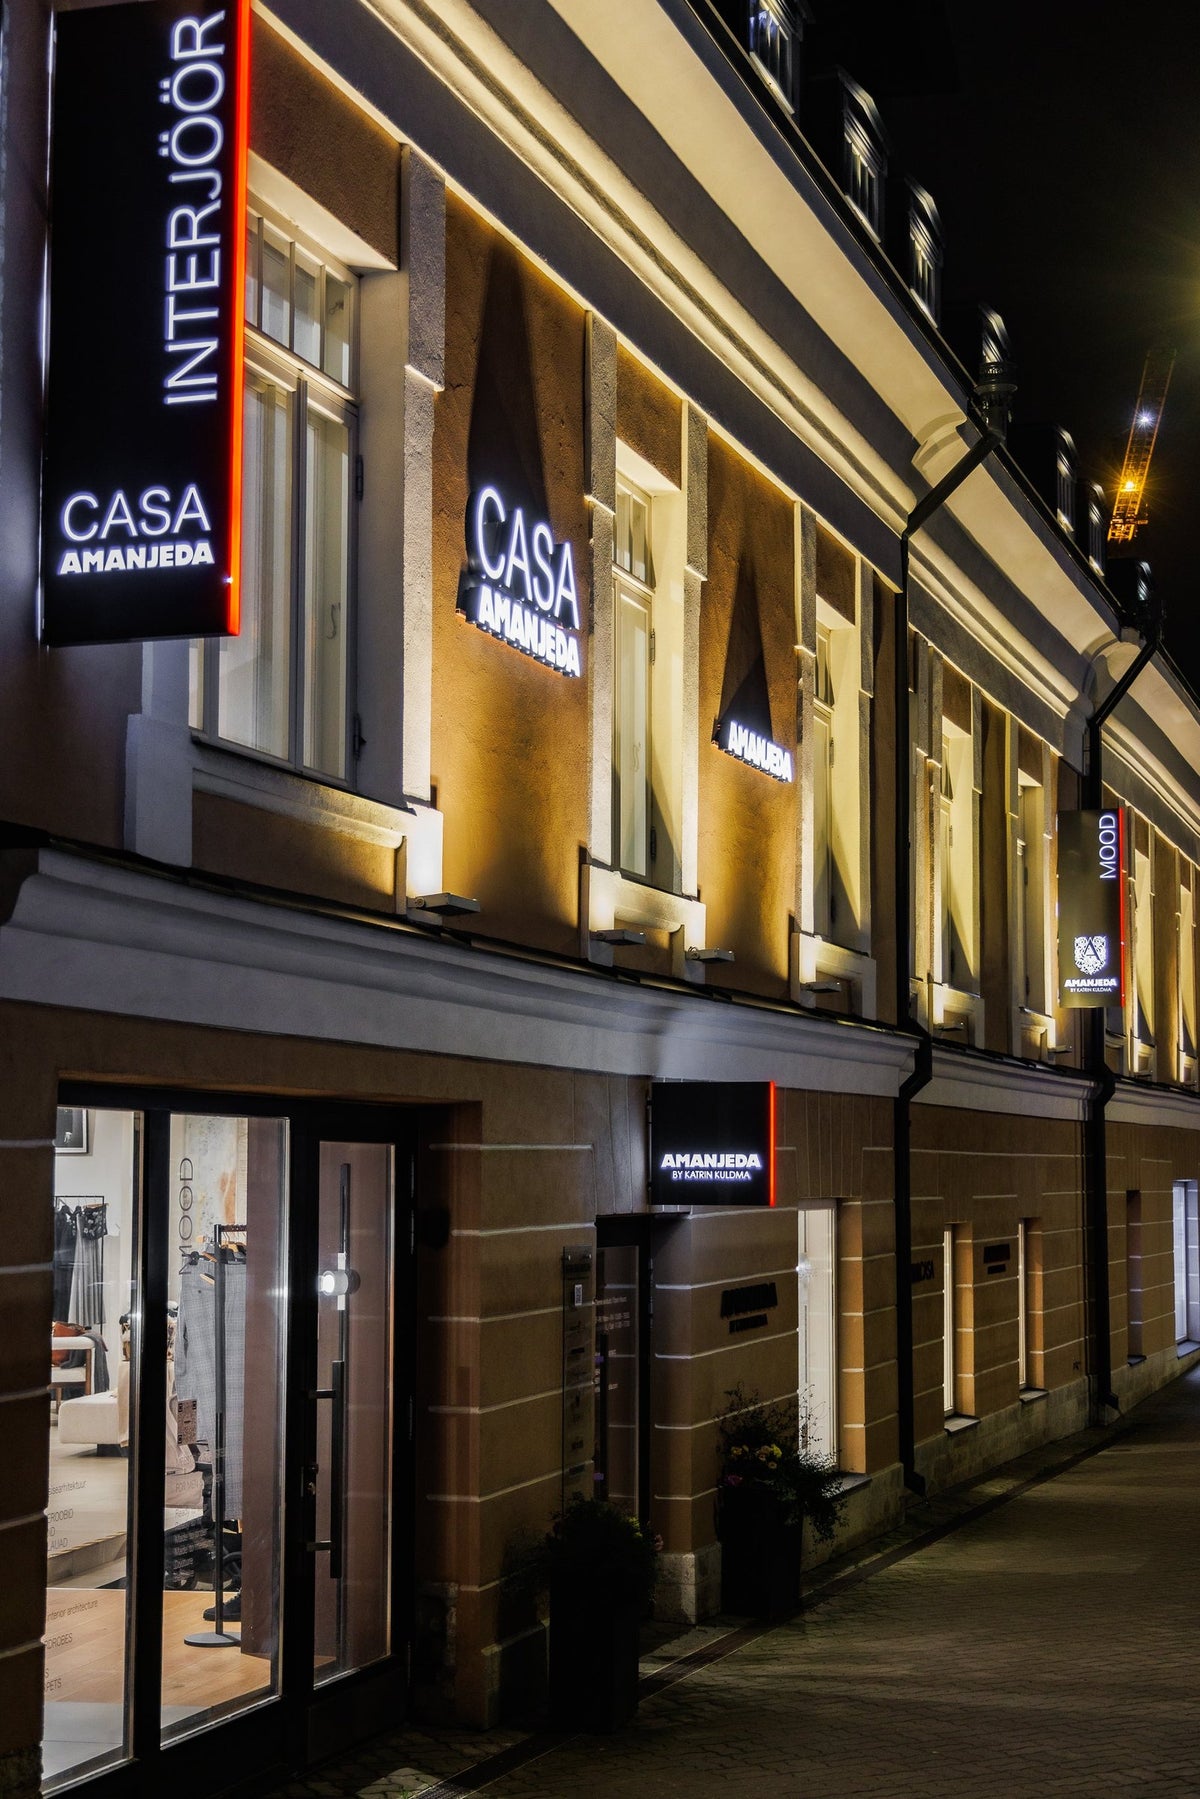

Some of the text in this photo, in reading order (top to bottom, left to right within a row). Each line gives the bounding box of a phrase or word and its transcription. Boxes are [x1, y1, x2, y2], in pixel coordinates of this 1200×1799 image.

[159, 8, 226, 407] INTERJÖÖR
[61, 484, 212, 541] CASA
[58, 541, 215, 576] AMANJEDA
[476, 486, 580, 631] CASA
[477, 584, 581, 678] AMANJEDA
[727, 720, 793, 784] AMANJEDA
[1098, 814, 1117, 879] MOOD
[1064, 978, 1118, 988] AMANJEDA
[660, 1153, 761, 1169] AMANJEDA
[672, 1169, 751, 1180] BY KATRIN KULDMA
[178, 1157, 194, 1275] MOOD
